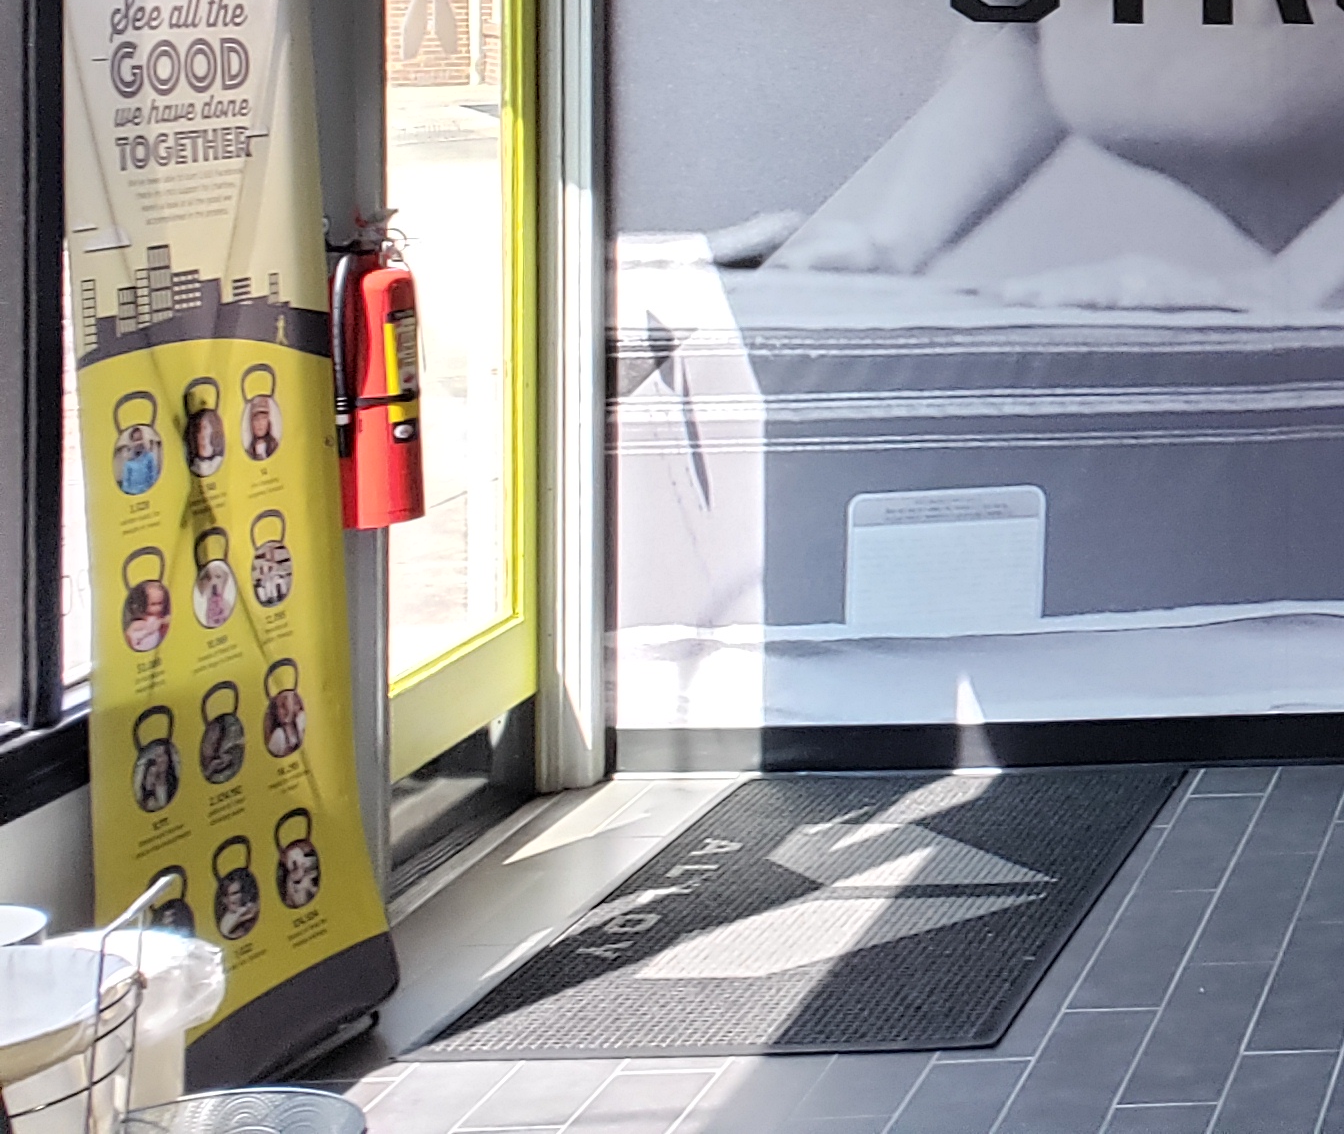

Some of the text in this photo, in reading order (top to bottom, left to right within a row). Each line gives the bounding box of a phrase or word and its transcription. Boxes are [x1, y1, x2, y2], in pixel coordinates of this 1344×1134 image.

[110, 37, 250, 99] GOOD
[114, 95, 252, 128] we have done
[115, 126, 253, 172] TOGETHER
